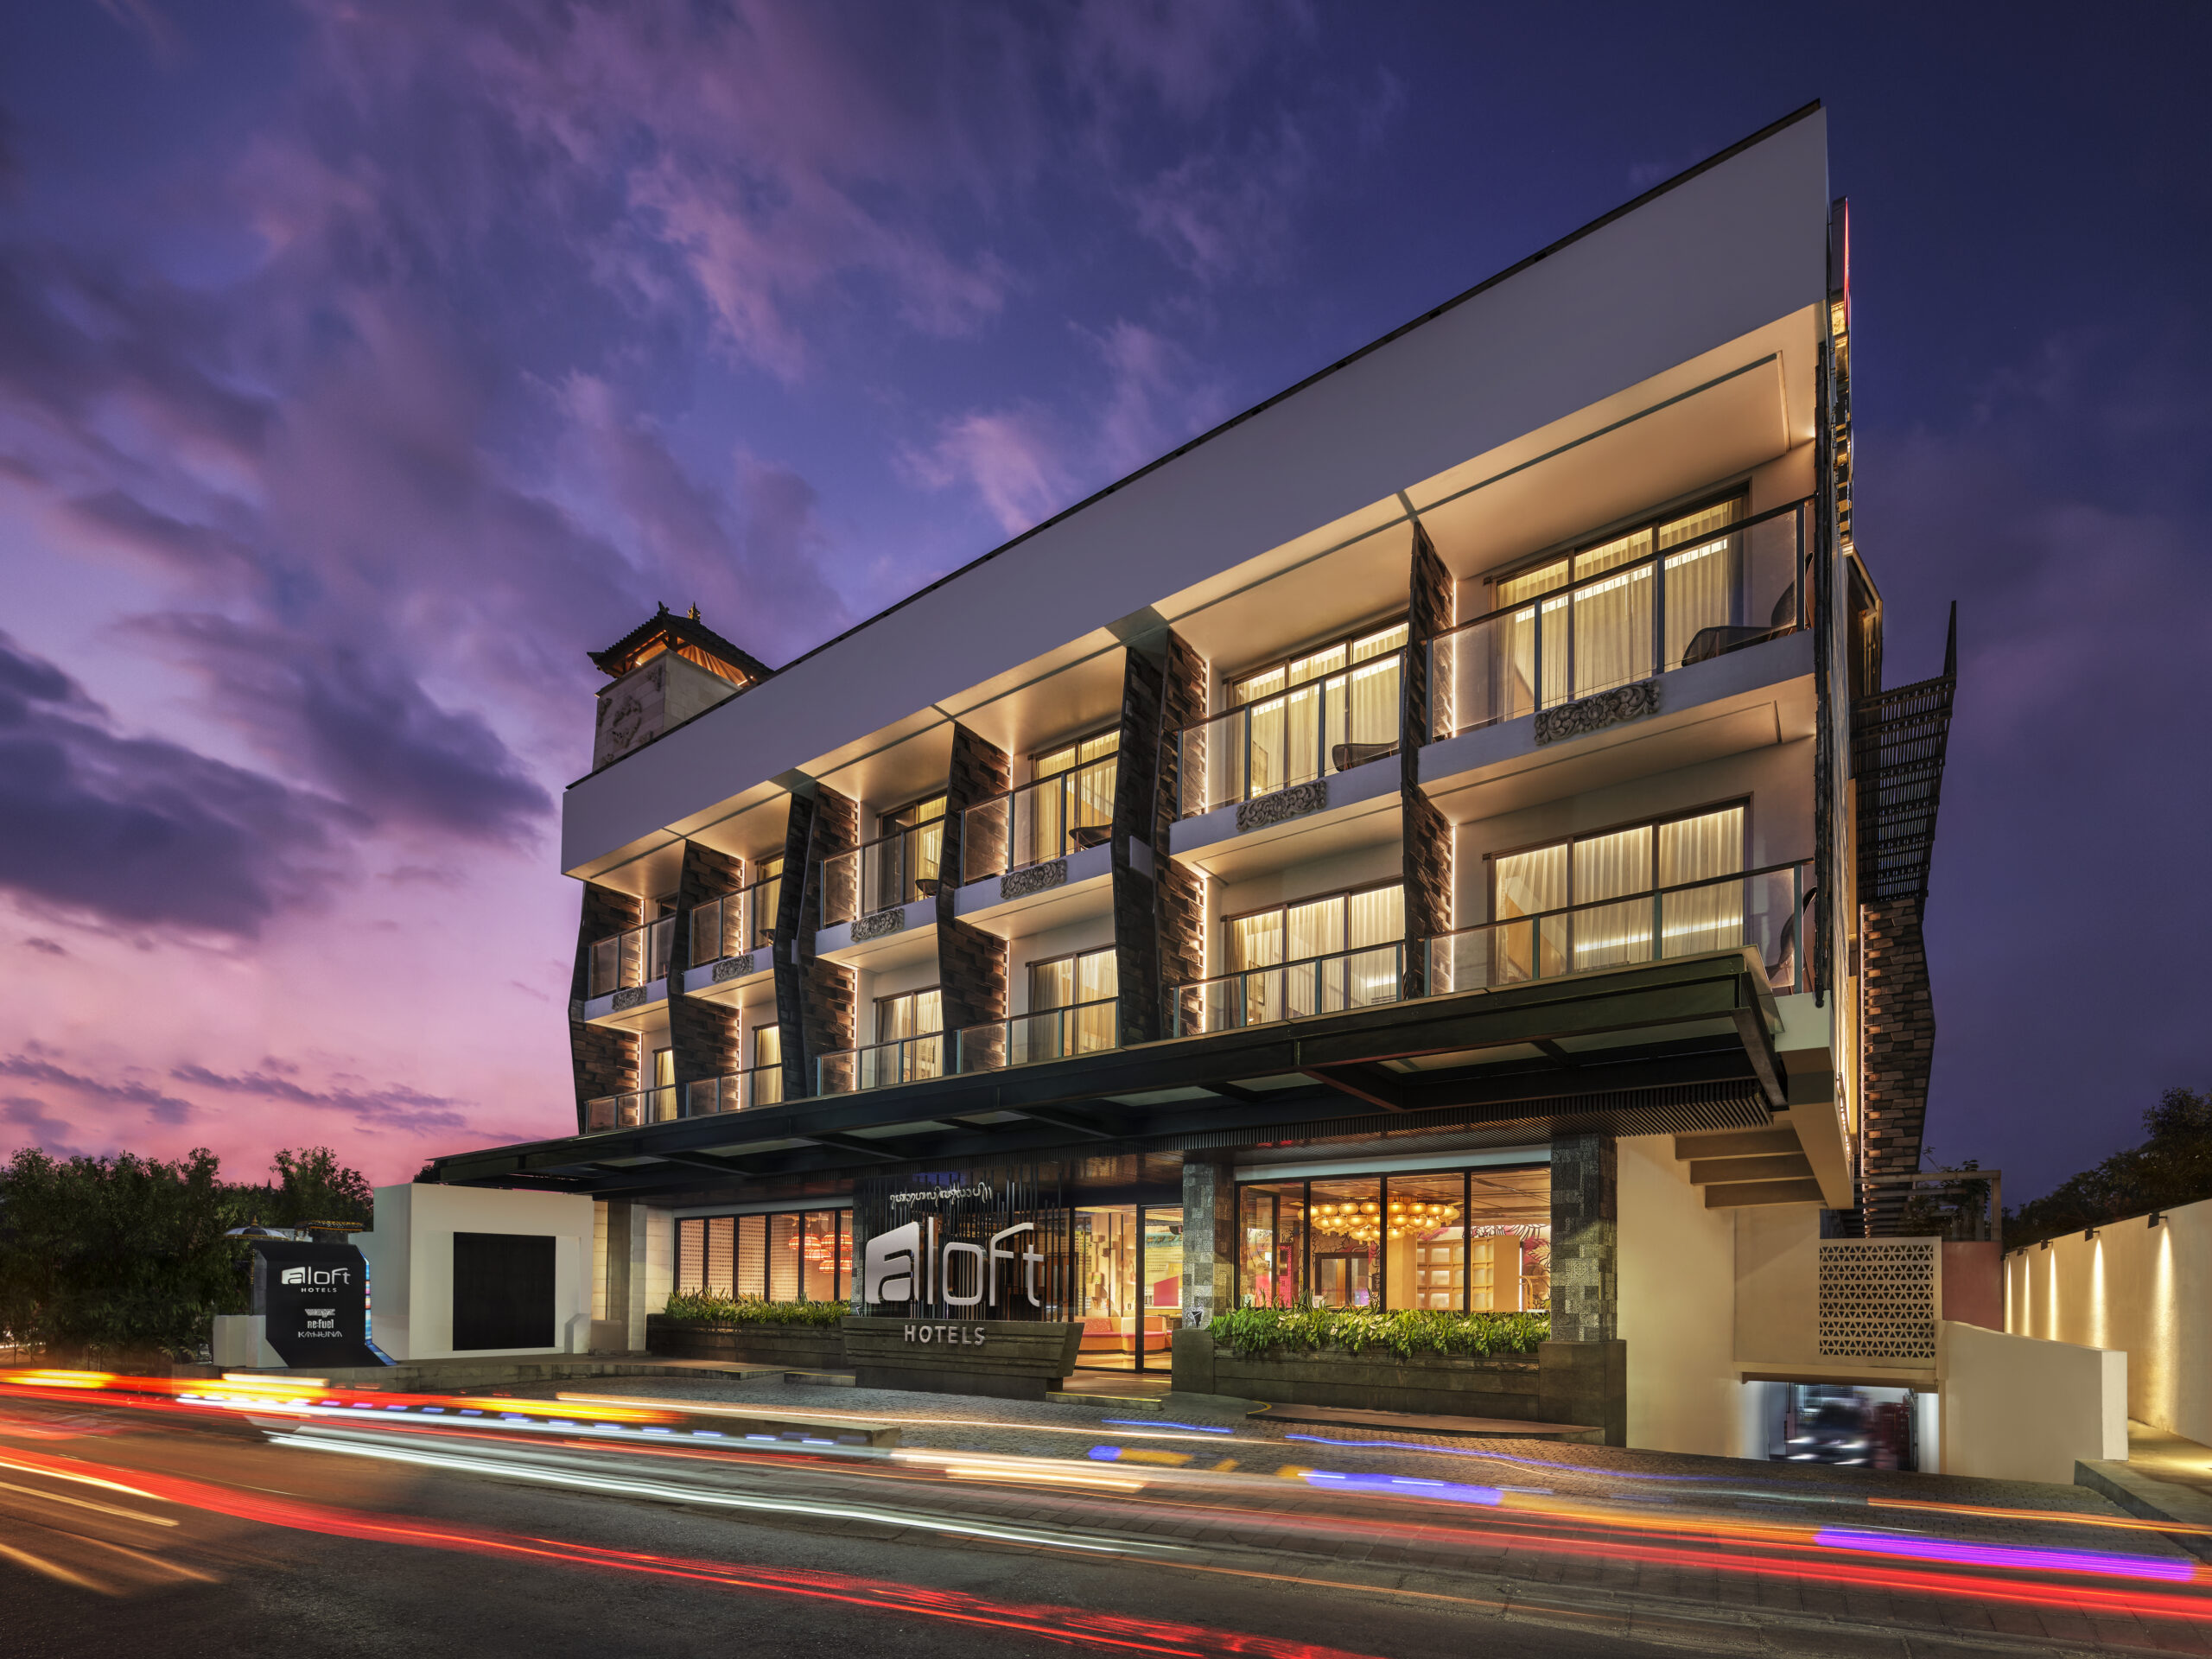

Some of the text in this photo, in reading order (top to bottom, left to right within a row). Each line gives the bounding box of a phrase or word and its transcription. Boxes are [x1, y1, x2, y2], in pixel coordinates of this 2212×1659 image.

[865, 1217, 1044, 1307] aloft
[281, 1266, 351, 1285] aloft
[904, 1325, 986, 1346] HOTELS
